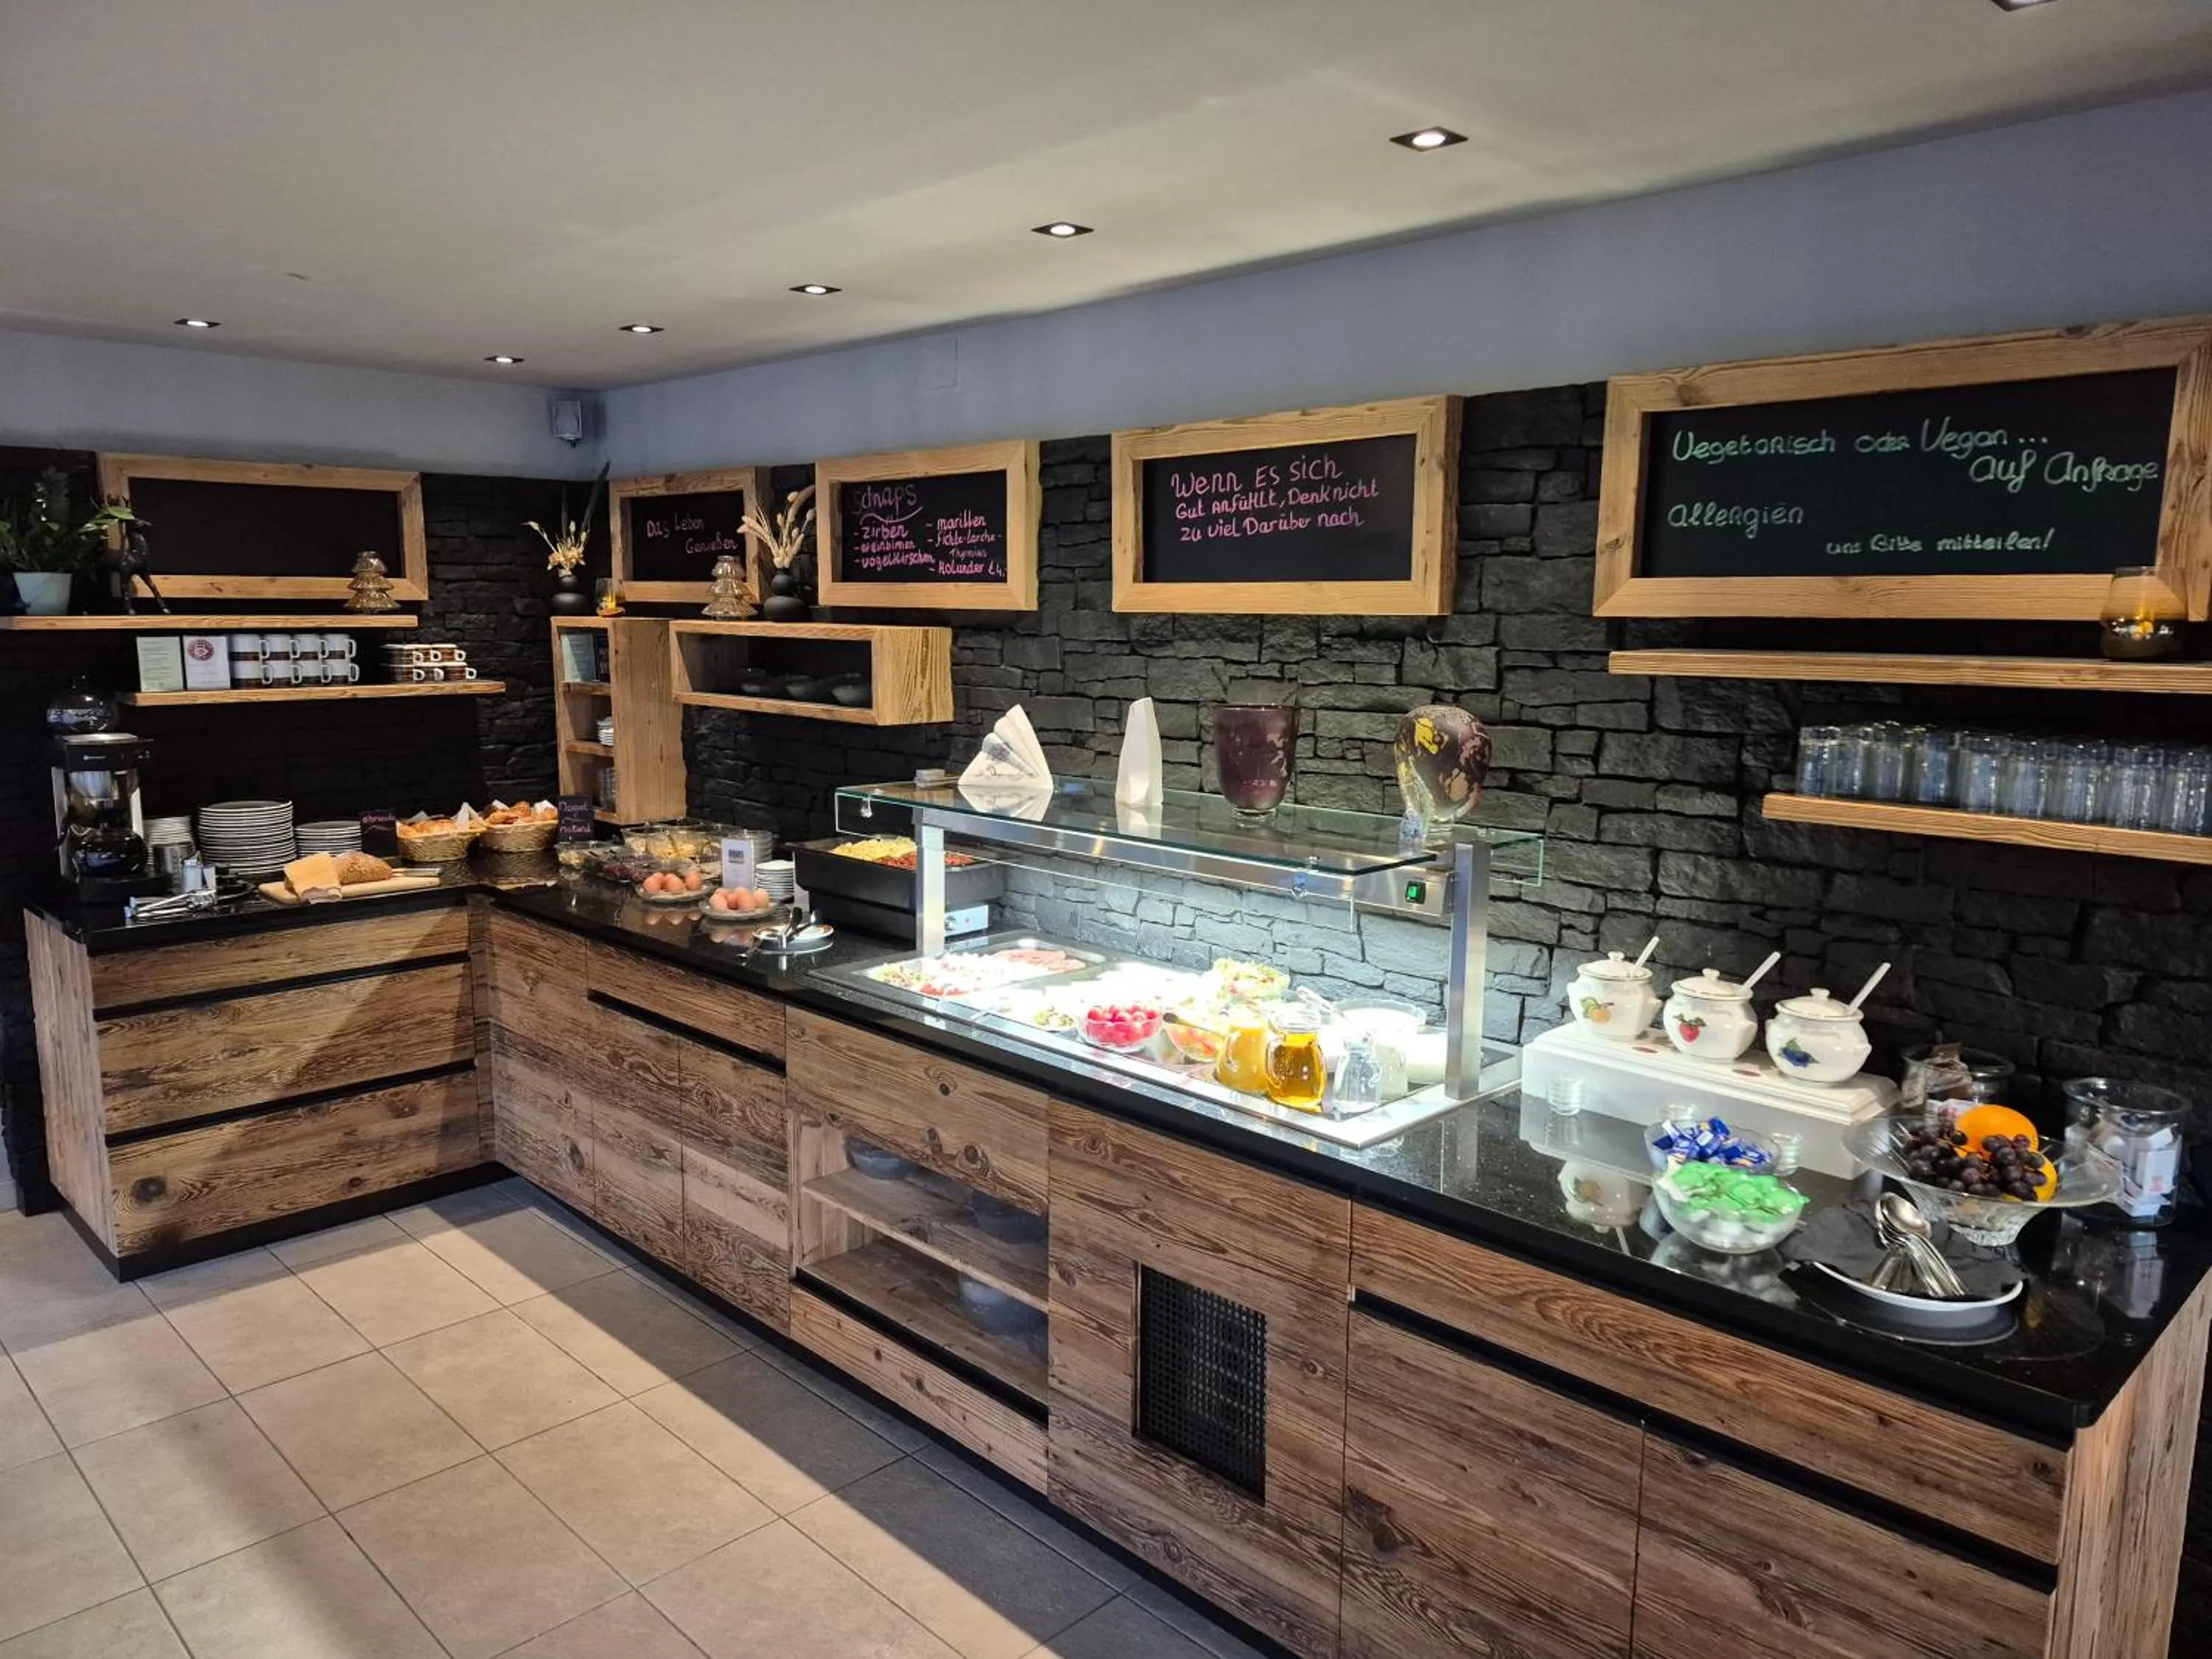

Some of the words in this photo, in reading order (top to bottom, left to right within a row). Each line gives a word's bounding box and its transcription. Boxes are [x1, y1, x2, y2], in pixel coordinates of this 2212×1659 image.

[1171, 470, 1242, 498] Wenn
[1175, 498, 1206, 520] Gut
[1332, 477, 1380, 502] nicht
[1318, 505, 1364, 528] nach
